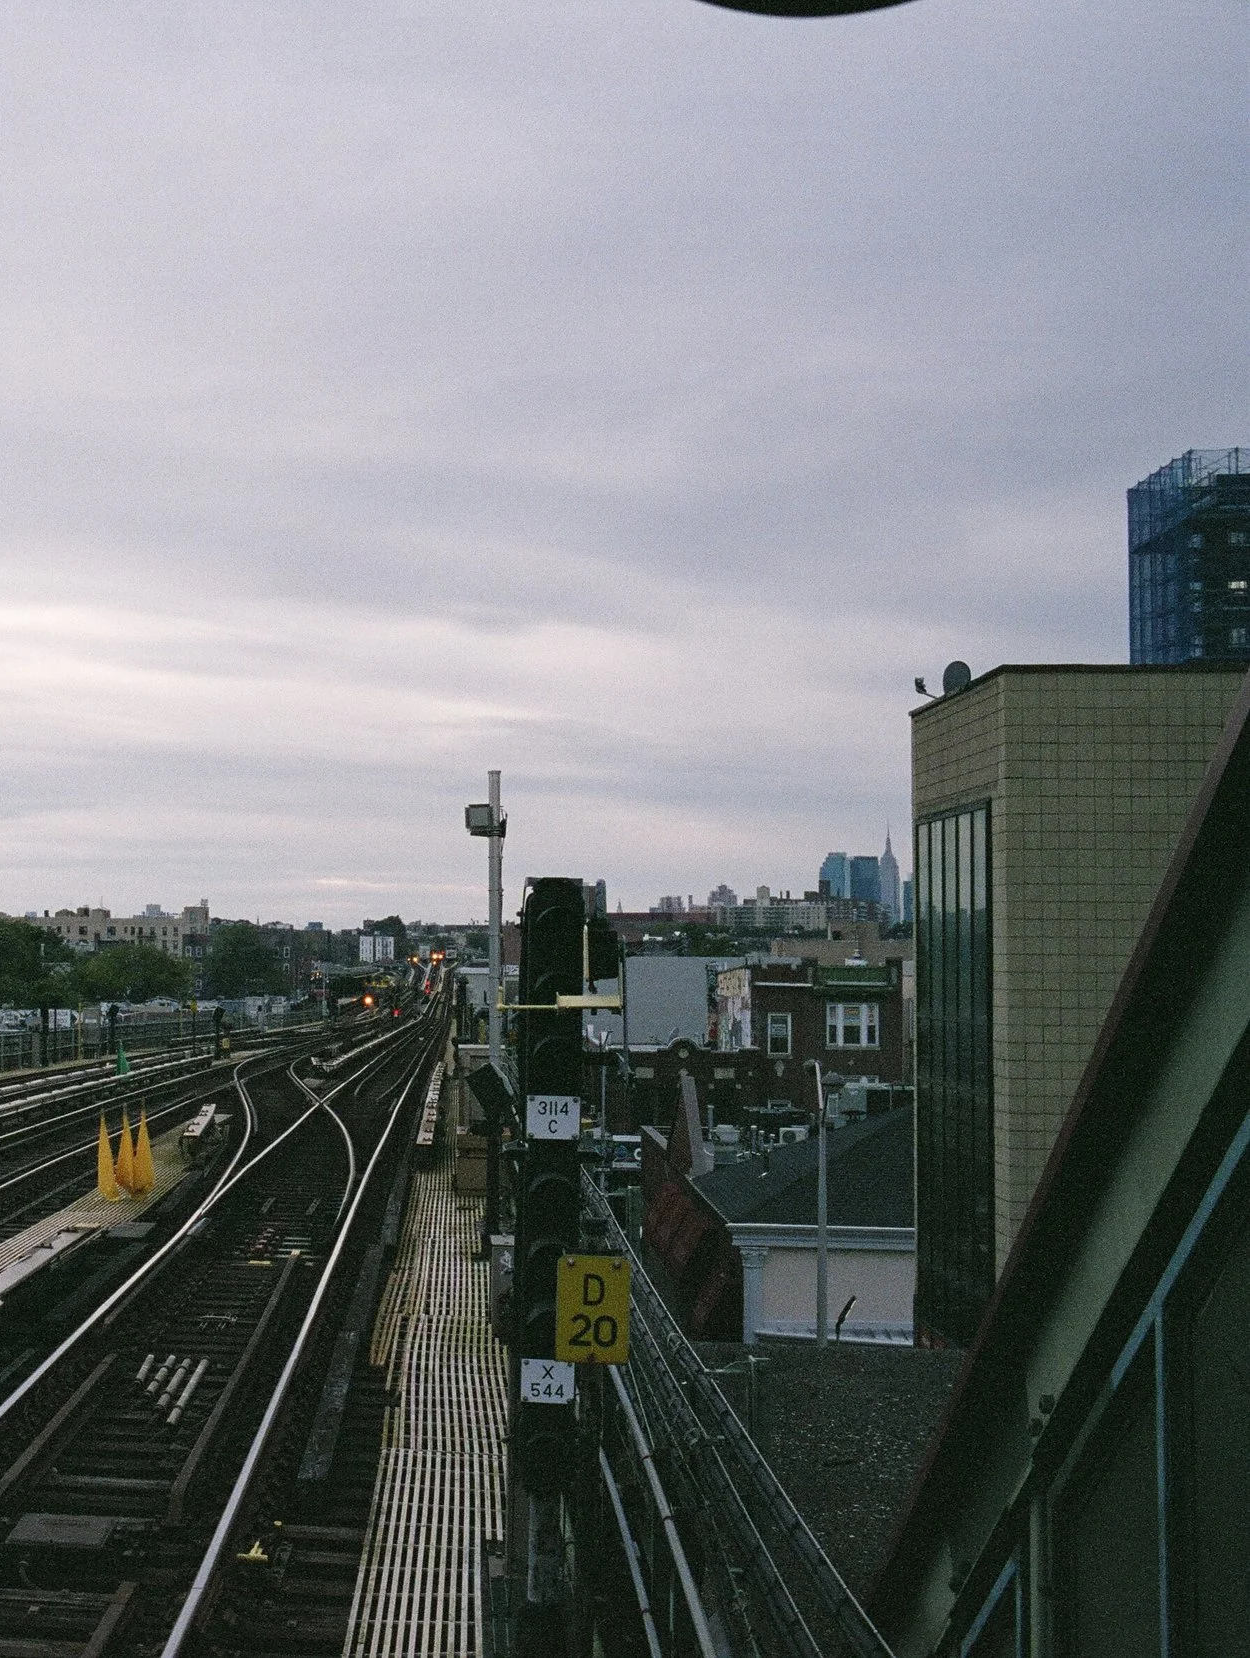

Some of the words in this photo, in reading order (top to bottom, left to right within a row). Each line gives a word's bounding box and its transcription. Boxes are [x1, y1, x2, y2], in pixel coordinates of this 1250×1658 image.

[537, 1101, 570, 1116] 3114
[548, 1120, 559, 1134] C
[583, 1273, 605, 1306] D
[568, 1314, 618, 1348] 20
[541, 1365, 555, 1380] X
[530, 1383, 565, 1398] 544
